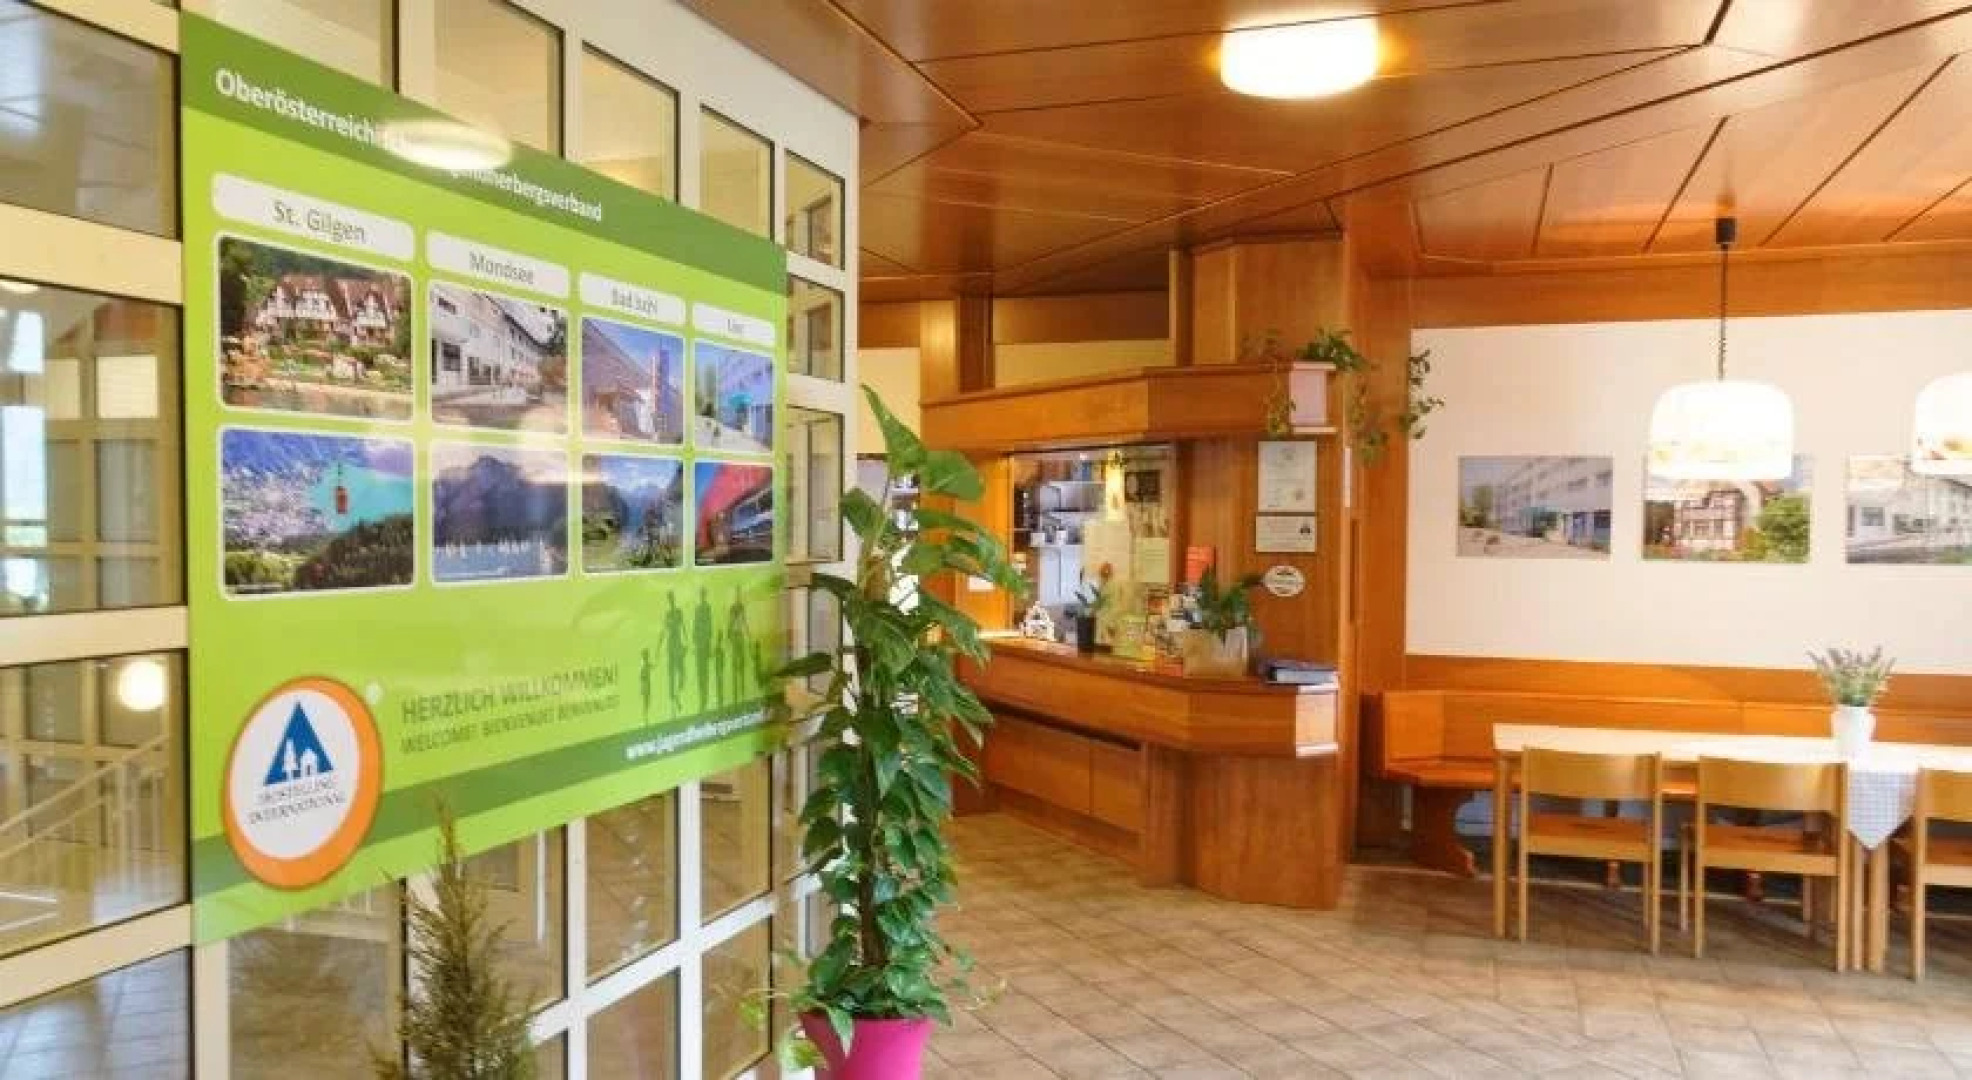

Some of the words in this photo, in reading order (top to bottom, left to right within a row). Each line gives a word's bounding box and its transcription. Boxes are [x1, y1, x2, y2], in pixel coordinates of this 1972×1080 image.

[213, 67, 383, 146] Oberösterreich
[272, 199, 300, 226] St.
[307, 208, 366, 244] Gilgen
[469, 250, 534, 285] Mondsee
[402, 690, 495, 723] HERZLICH
